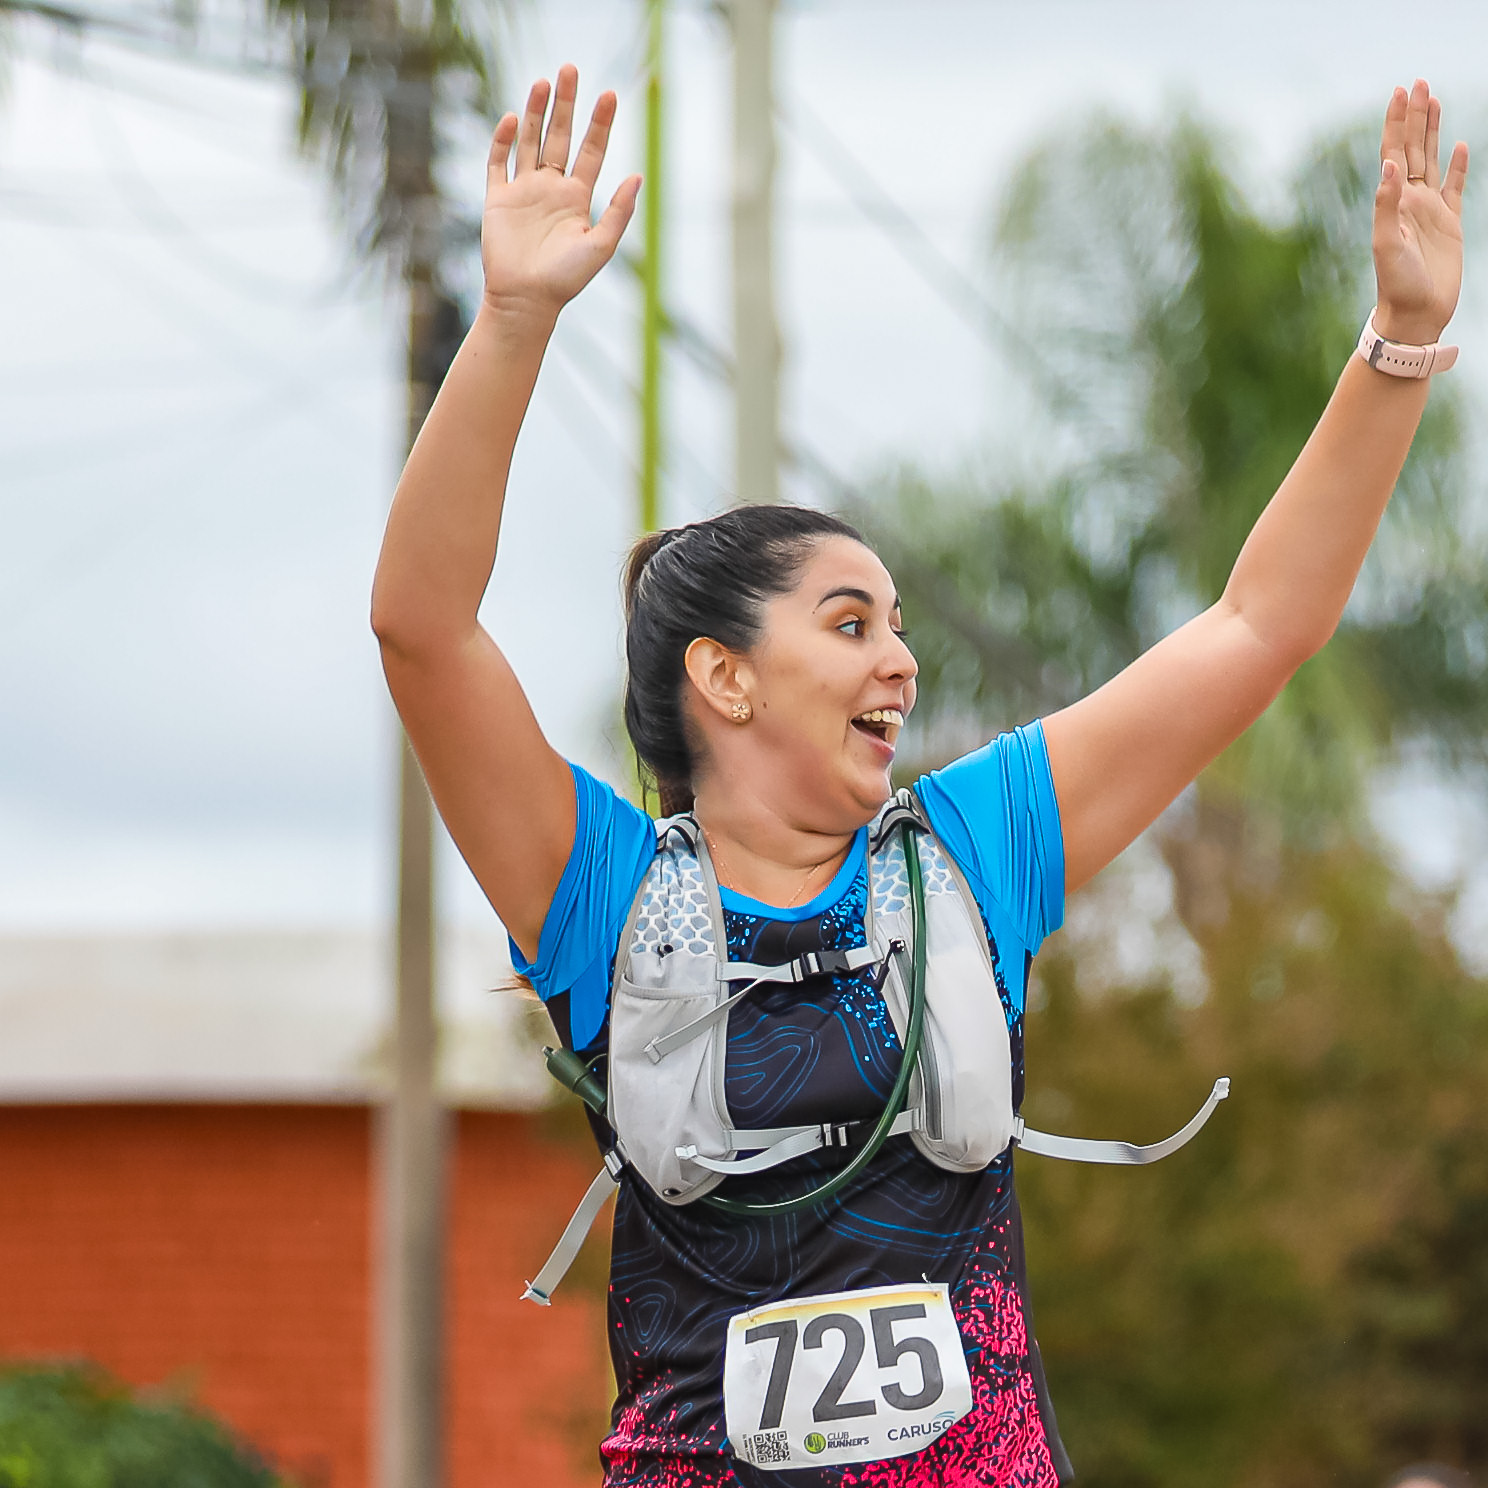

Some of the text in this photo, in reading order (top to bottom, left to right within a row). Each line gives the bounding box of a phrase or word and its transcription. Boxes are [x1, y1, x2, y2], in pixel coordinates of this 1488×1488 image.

[744, 1303, 944, 1431] 725
[827, 1431, 850, 1441] CLUB
[887, 1419, 954, 1441] CARUSO
